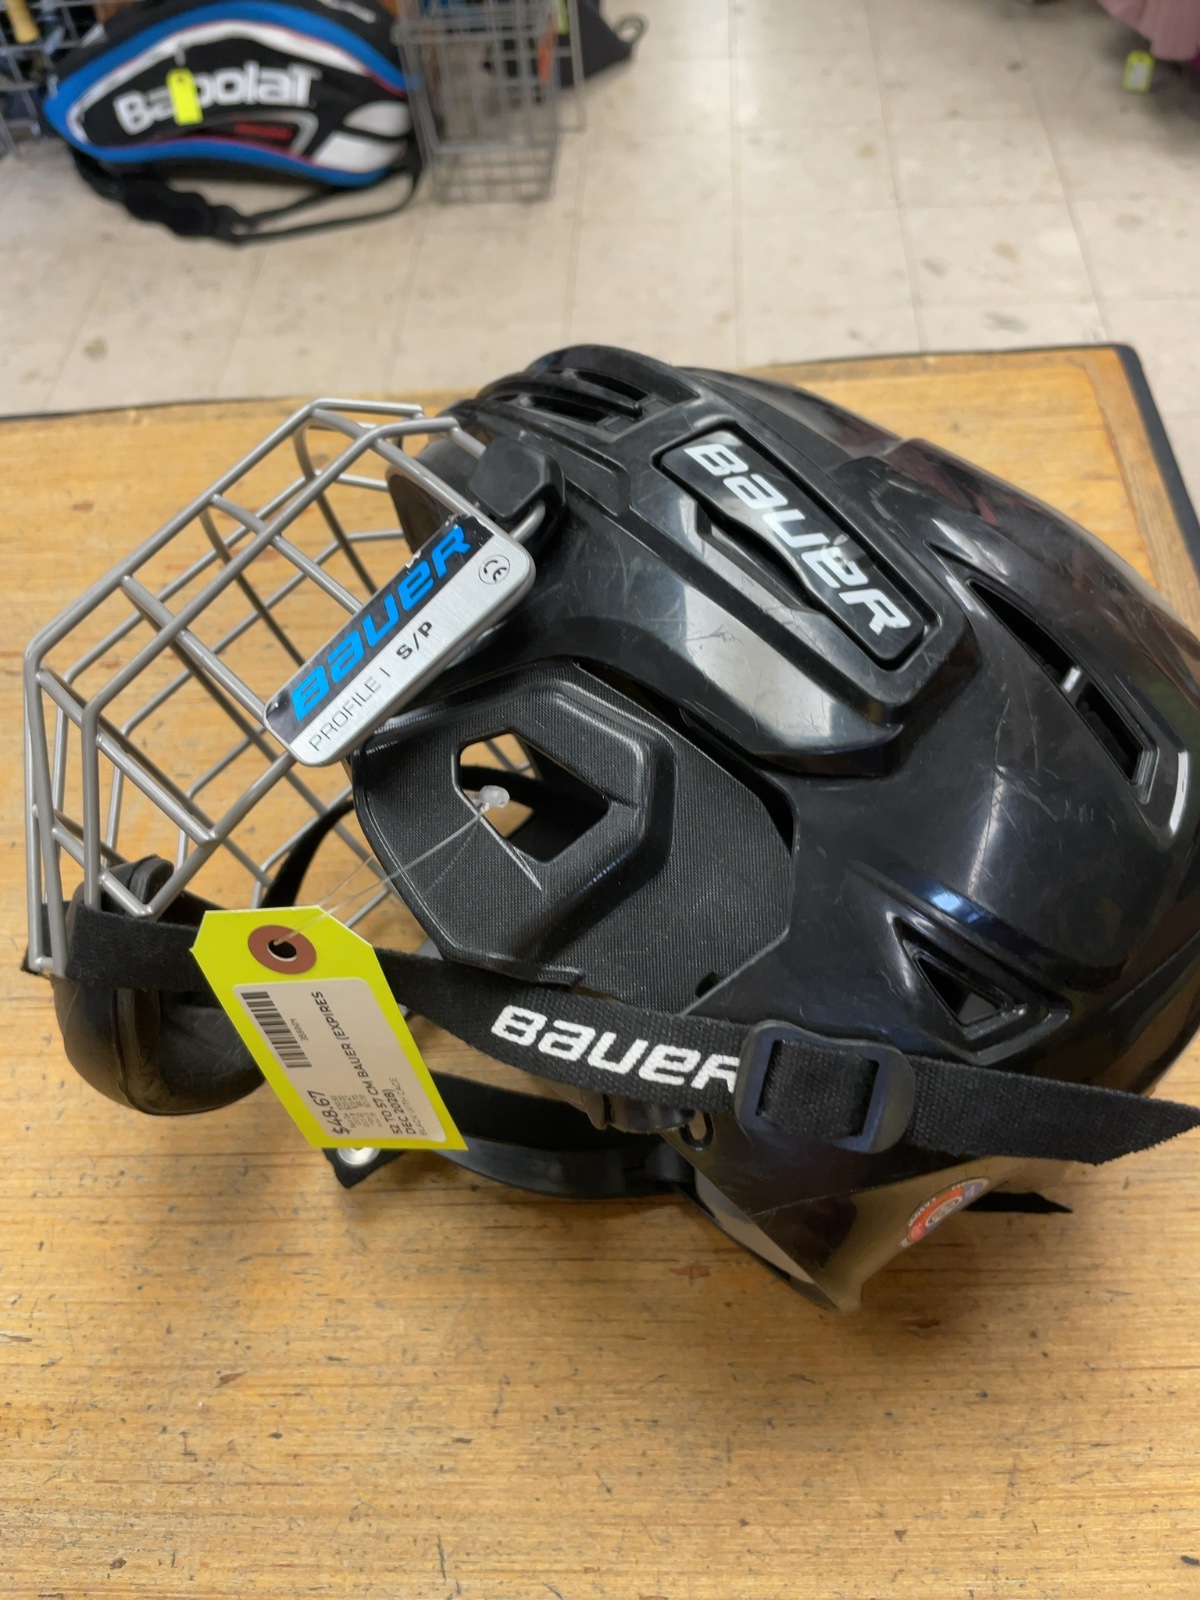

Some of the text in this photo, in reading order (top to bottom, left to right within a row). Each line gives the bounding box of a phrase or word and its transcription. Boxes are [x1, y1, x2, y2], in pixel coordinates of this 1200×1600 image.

[308, 677, 381, 751] PROFILE
[396, 621, 433, 660] S/P
[311, 991, 403, 1135] 52 TO 57 CM BAUER (EXPIRES
[307, 1090, 351, 1135] $48.67
[382, 1088, 417, 1135] DEC 2028)
